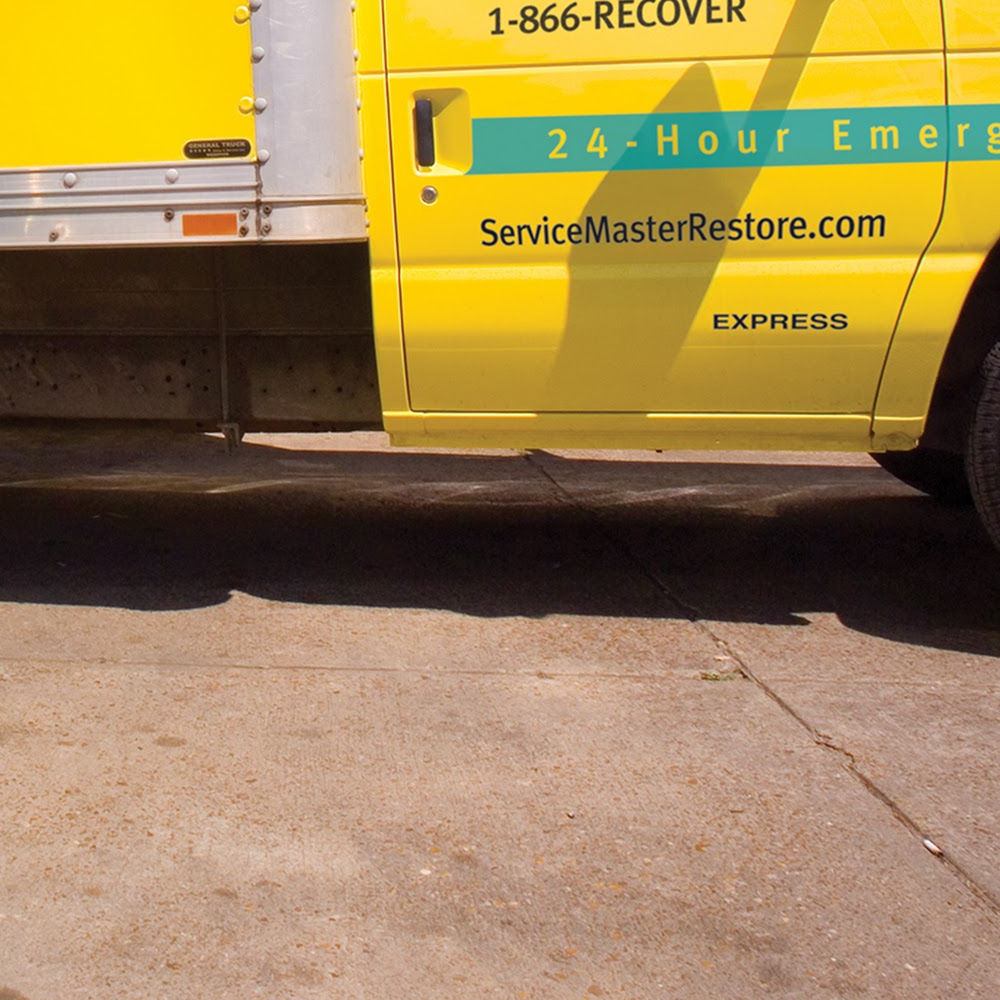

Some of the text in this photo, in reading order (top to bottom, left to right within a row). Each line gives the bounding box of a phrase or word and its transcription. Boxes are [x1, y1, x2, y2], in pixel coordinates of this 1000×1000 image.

[547, 119, 1000, 159] 24-Hour Emerg
[480, 213, 886, 247] ServiceMasterRestore.com
[713, 313, 849, 331] EXPRESS
